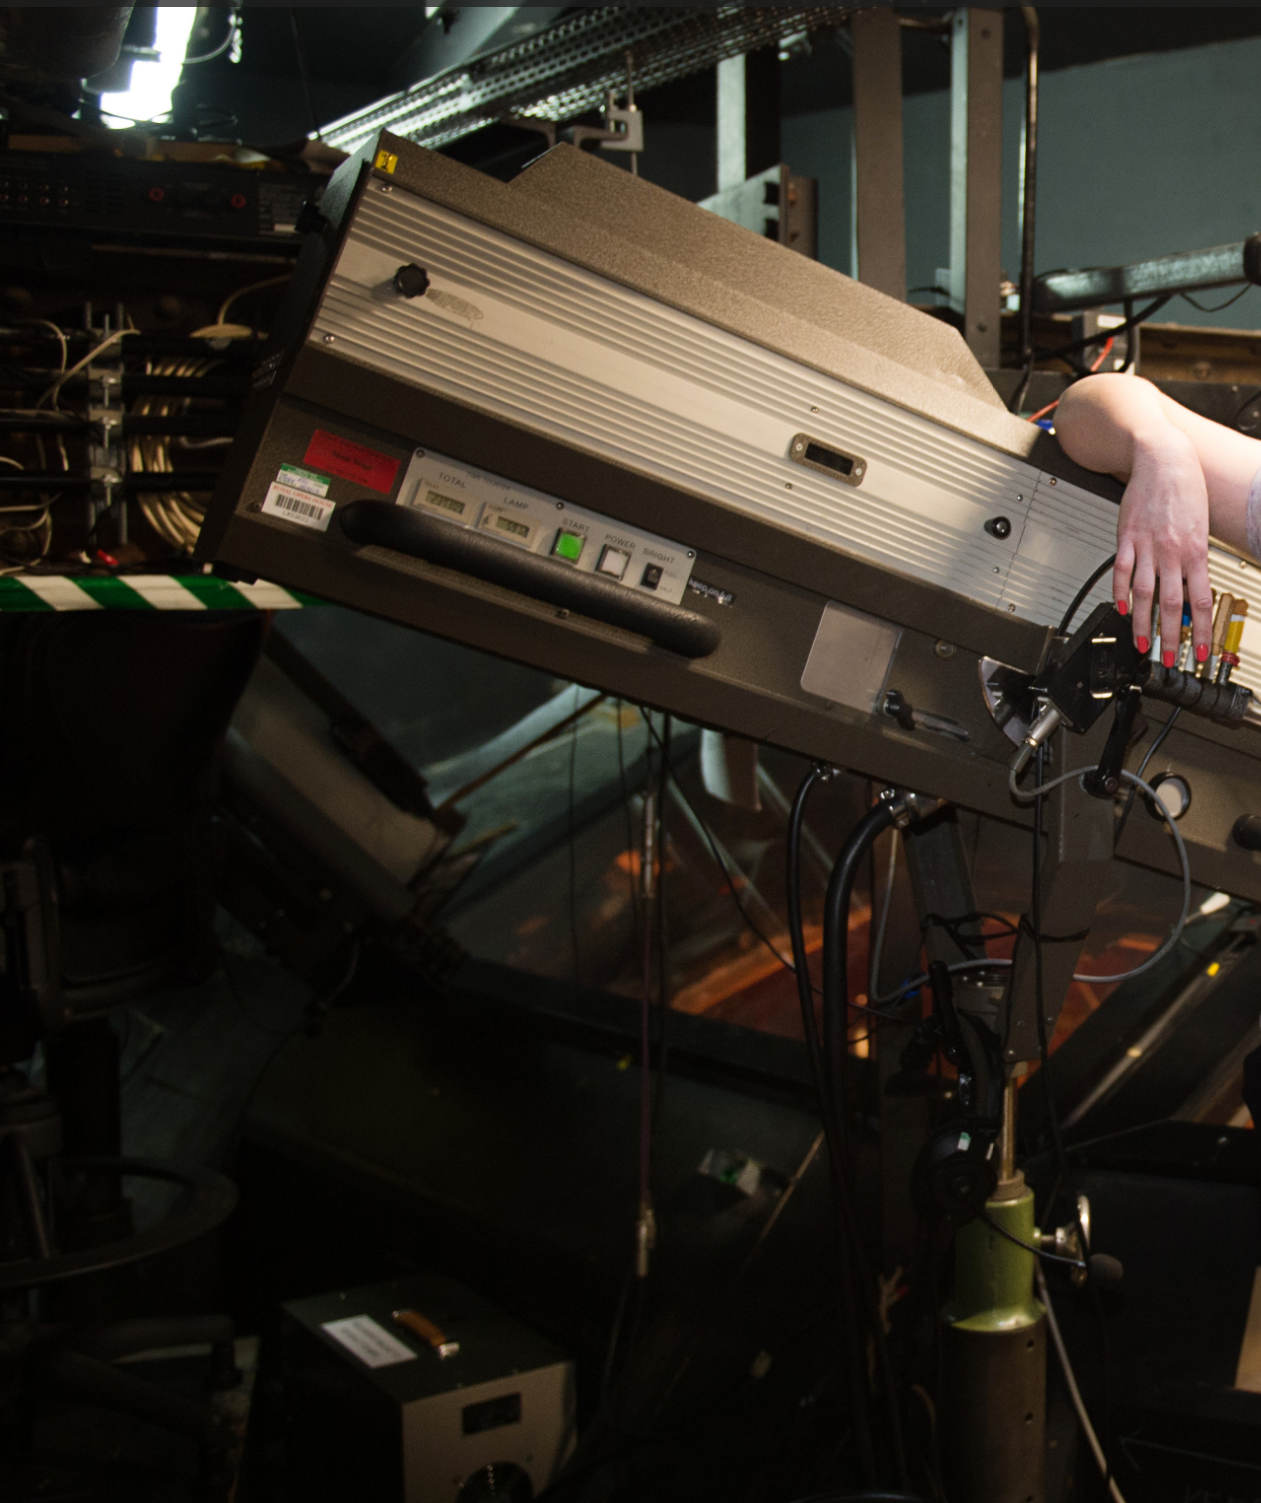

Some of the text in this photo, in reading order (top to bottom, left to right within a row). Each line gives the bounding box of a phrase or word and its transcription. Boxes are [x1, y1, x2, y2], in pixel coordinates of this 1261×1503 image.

[437, 472, 468, 489] TOTAL
[273, 484, 333, 509] ROYAL OPERA HOUSE
[503, 497, 529, 510] LAMP
[563, 518, 590, 533] START
[605, 533, 636, 549] POWER
[643, 548, 675, 565] BRIGHT
[688, 577, 709, 592] keep
[708, 587, 720, 596] on
